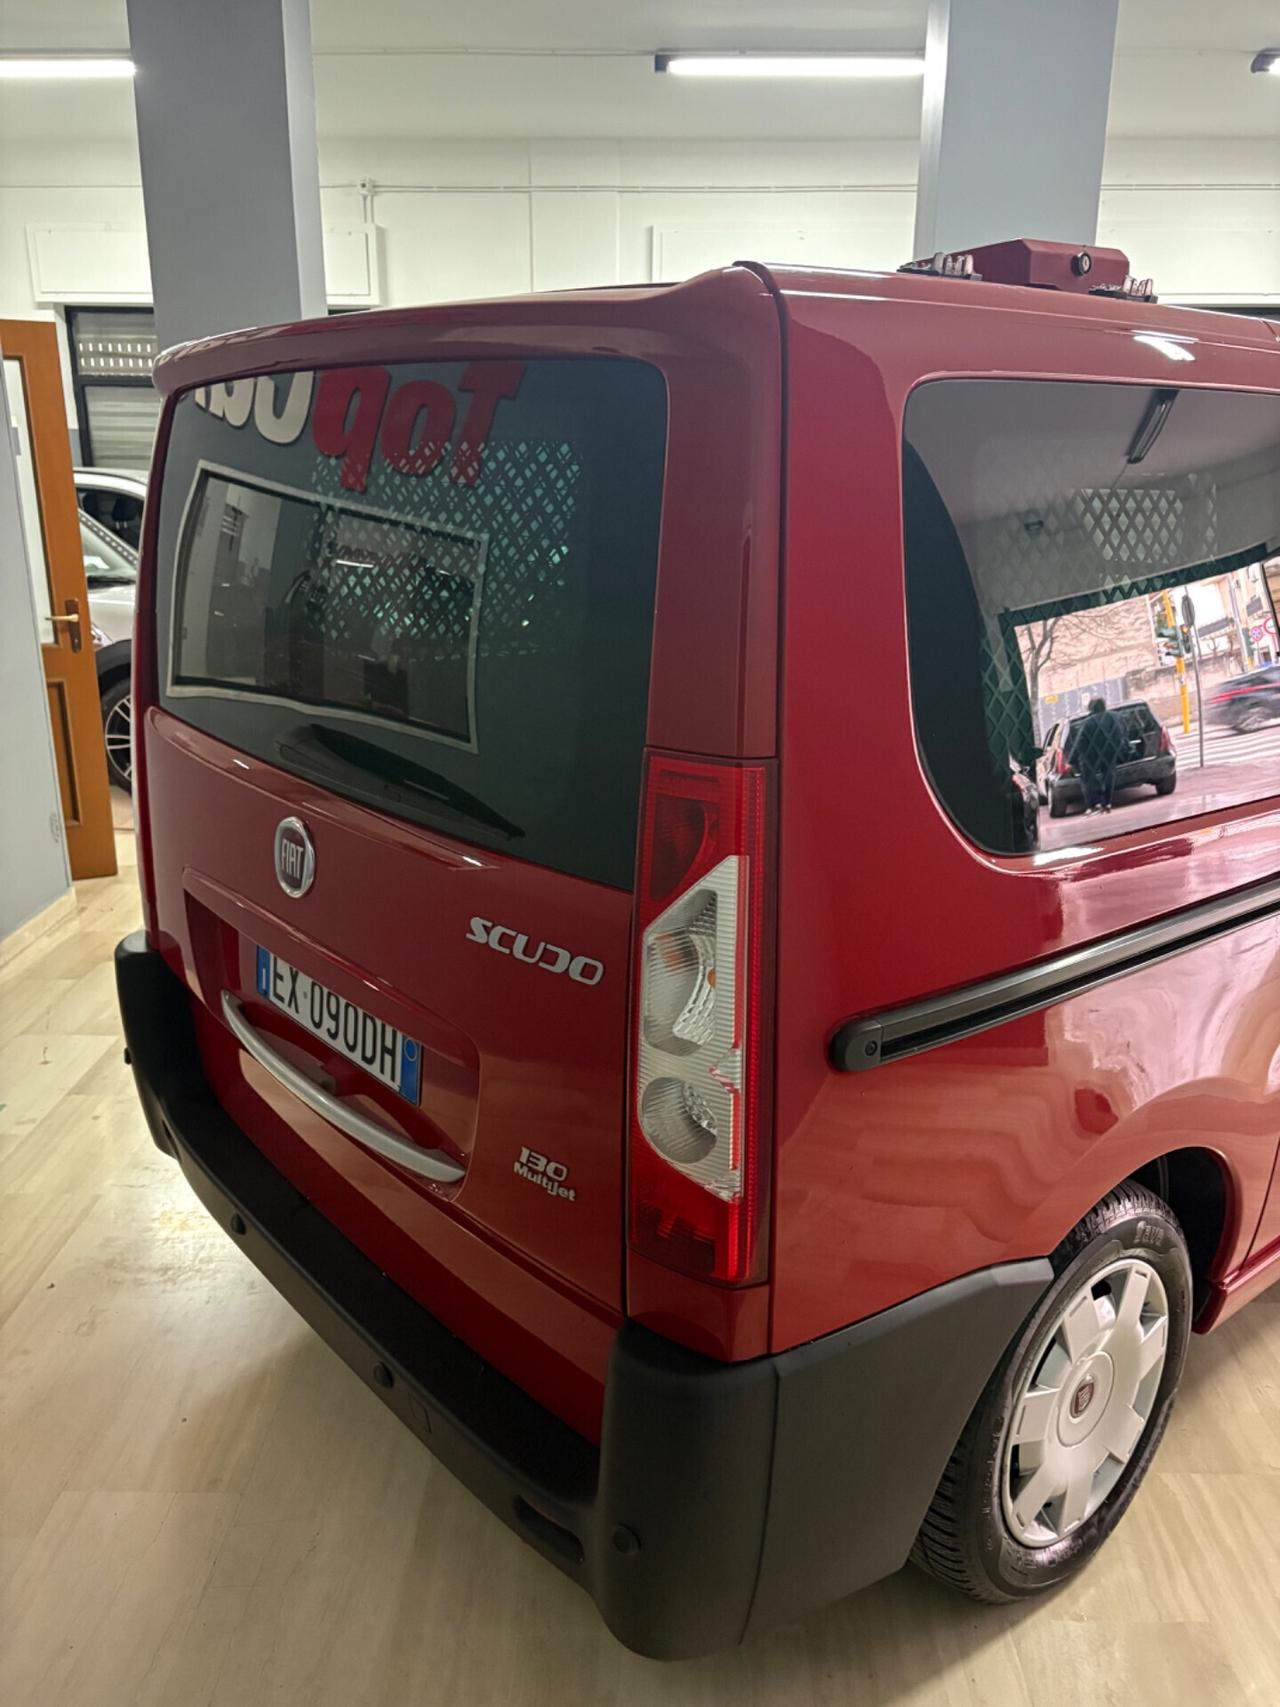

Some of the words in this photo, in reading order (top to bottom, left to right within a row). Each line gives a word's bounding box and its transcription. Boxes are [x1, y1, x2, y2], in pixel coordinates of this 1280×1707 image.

[281, 838, 304, 880] FIAT
[465, 916, 604, 986] SCUDO
[272, 955, 300, 1014] EX
[310, 980, 398, 1082] 090DH
[520, 1146, 568, 1181] 130
